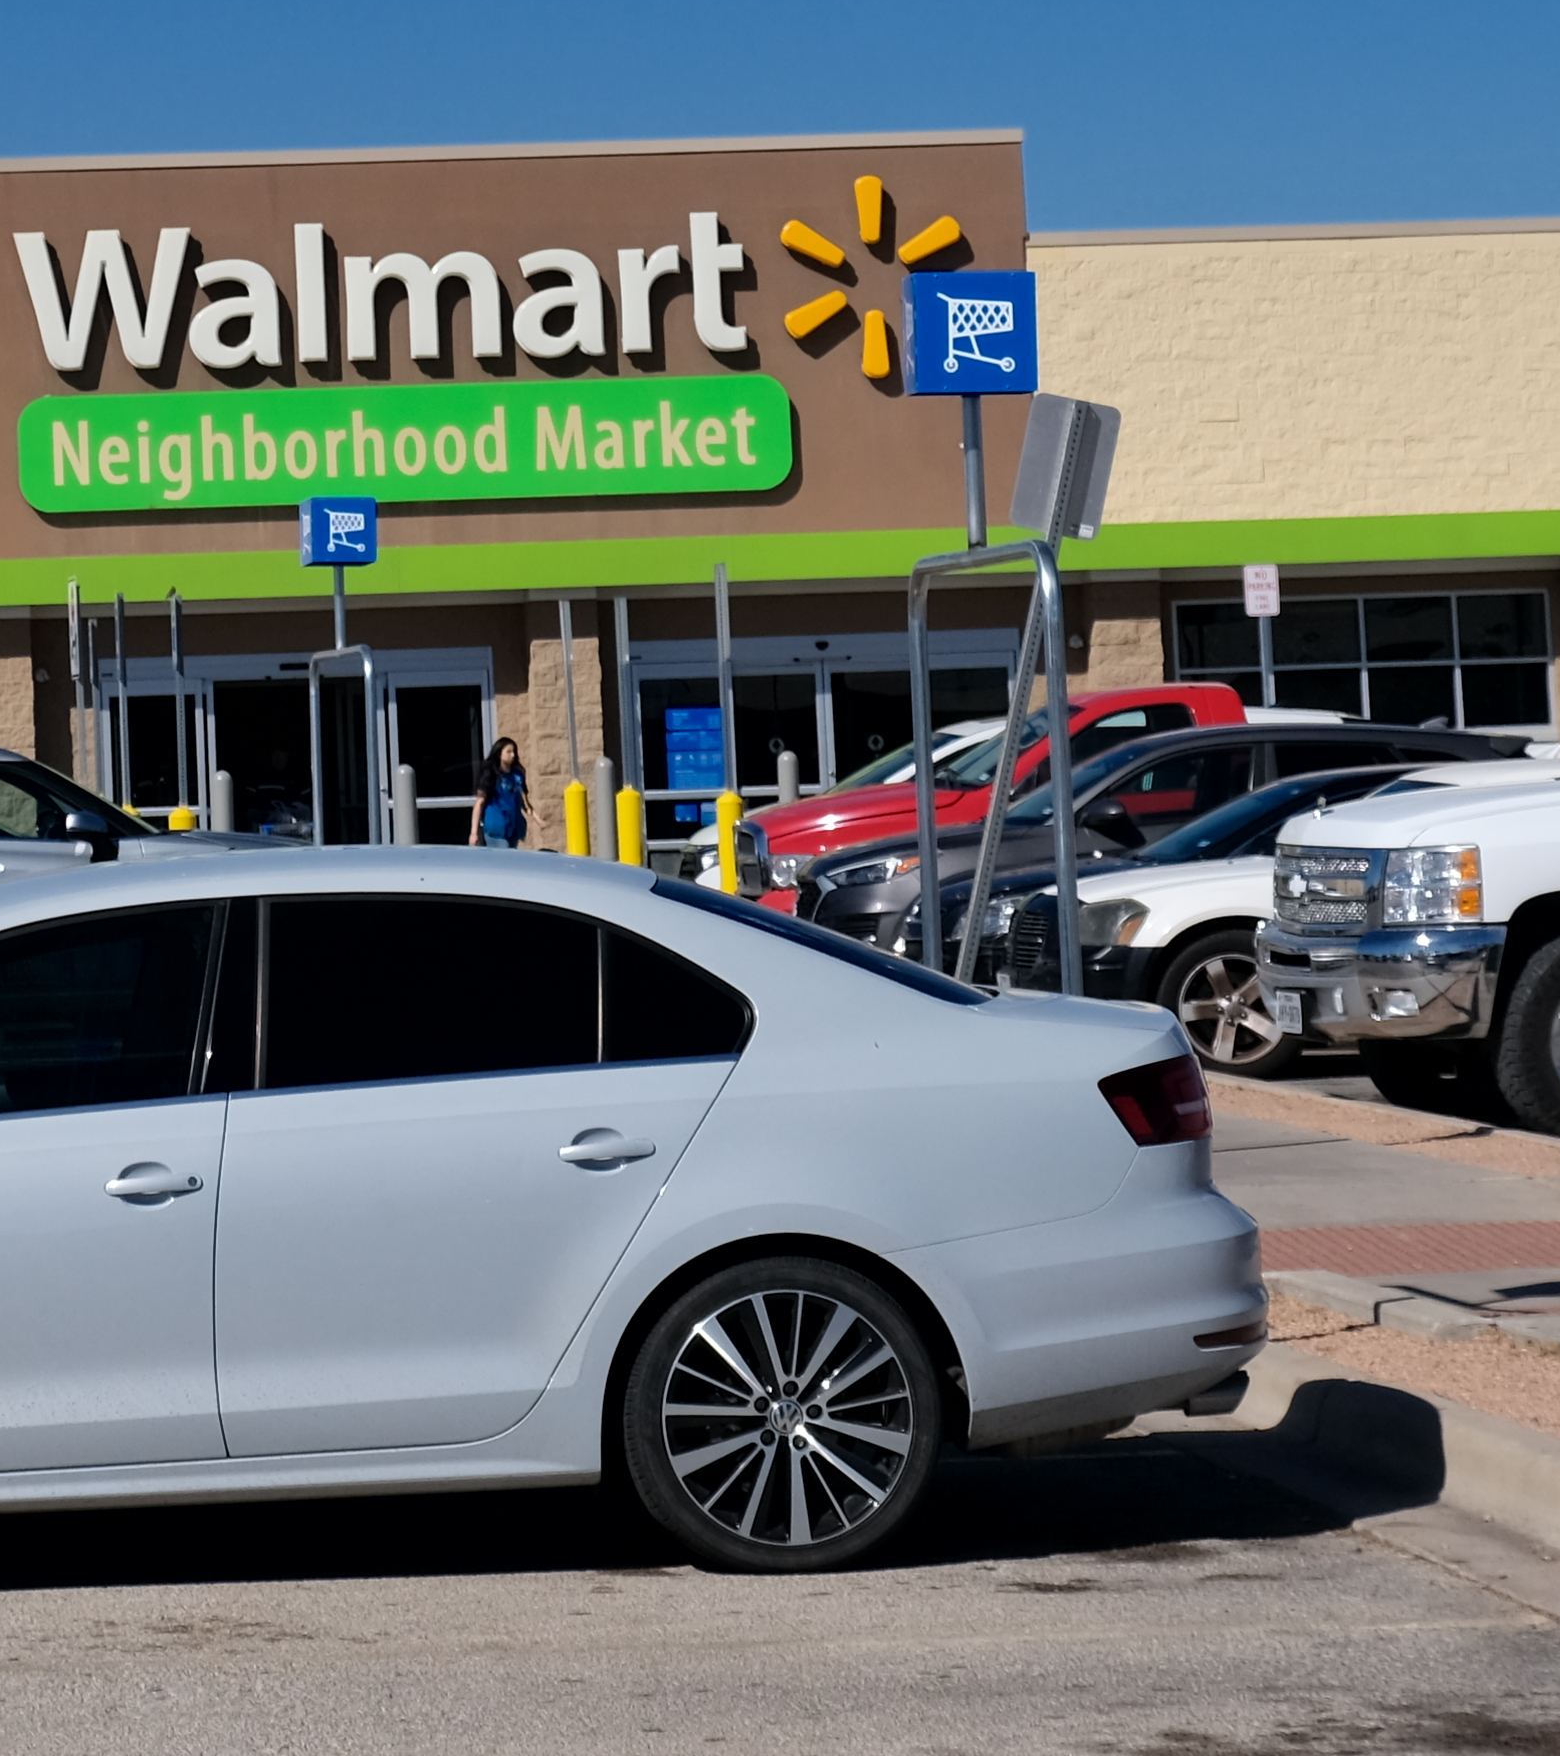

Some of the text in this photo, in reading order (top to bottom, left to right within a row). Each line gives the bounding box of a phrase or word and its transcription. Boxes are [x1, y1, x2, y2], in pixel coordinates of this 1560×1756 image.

[12, 211, 748, 372] Walmart
[51, 400, 758, 501] Neighborhood Market
